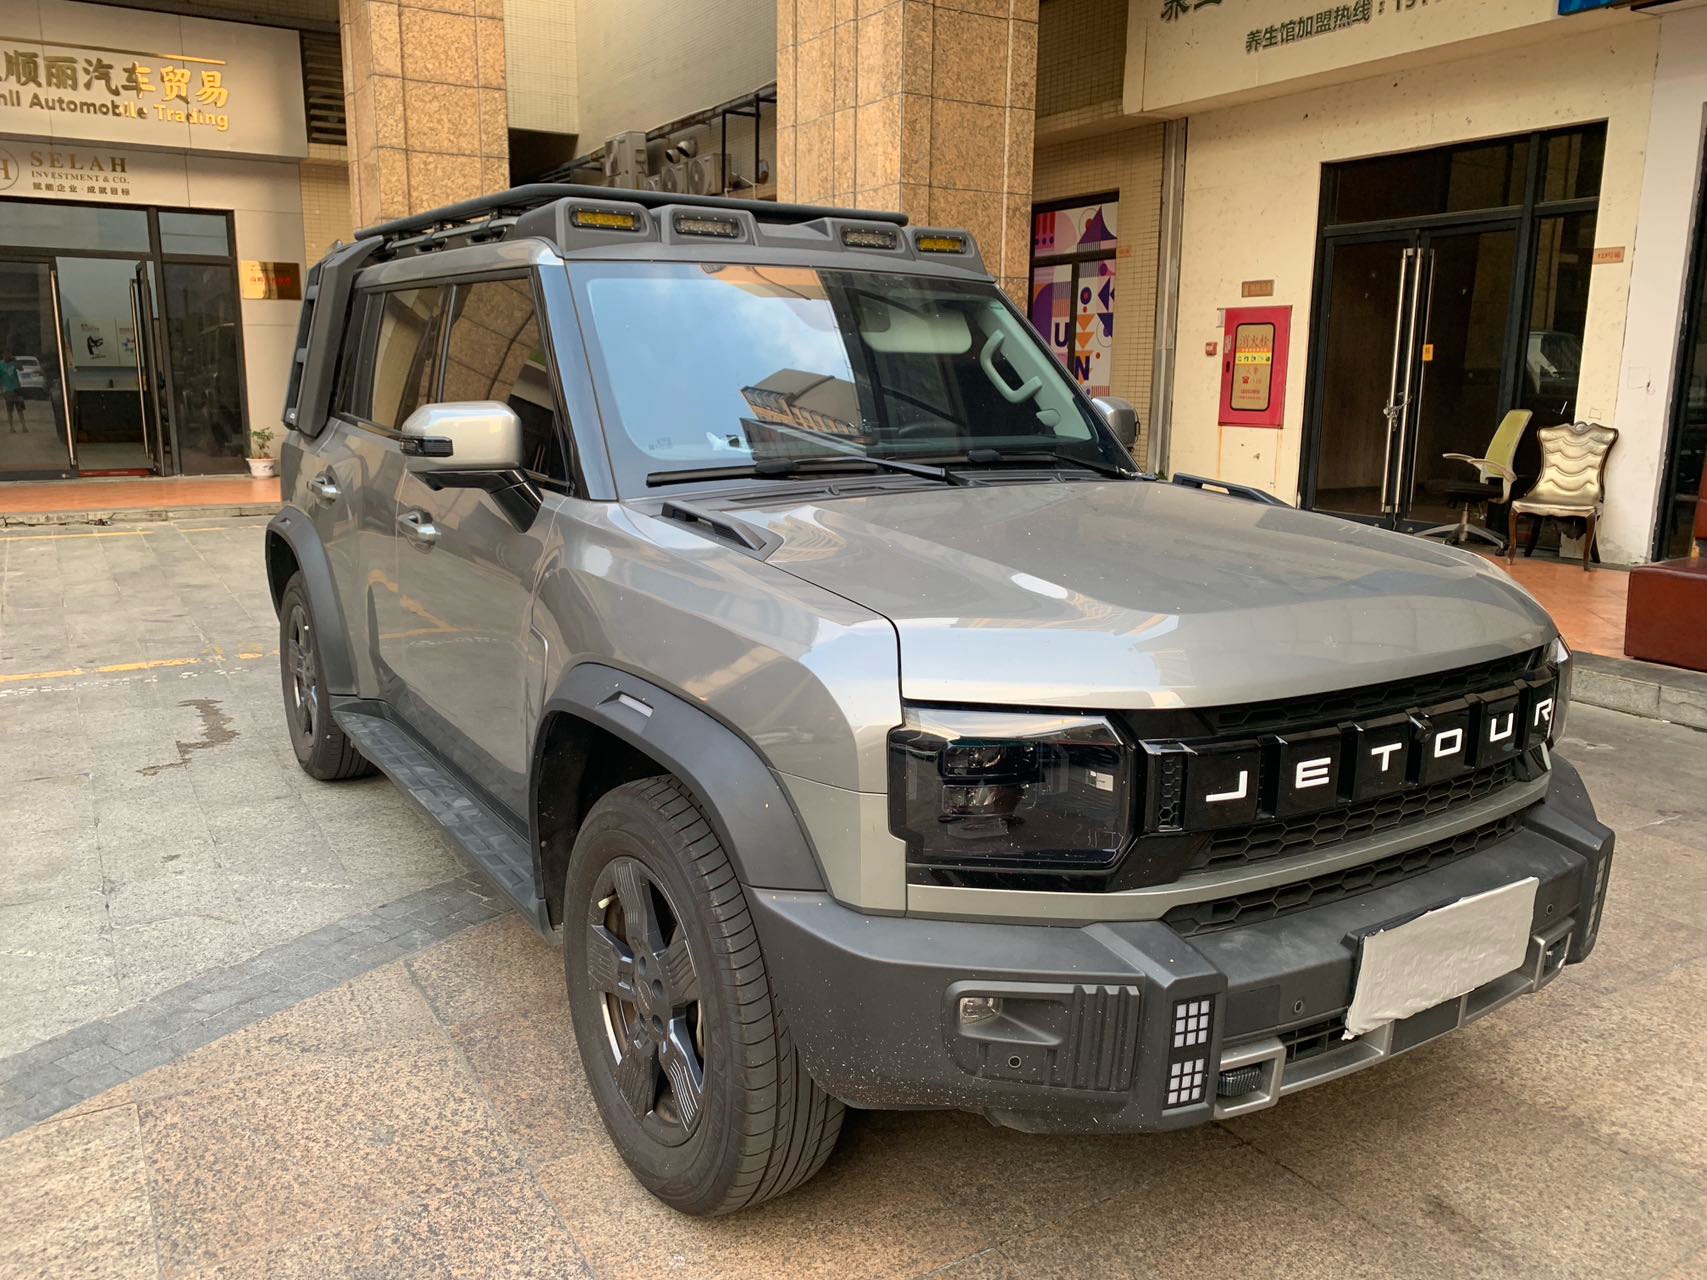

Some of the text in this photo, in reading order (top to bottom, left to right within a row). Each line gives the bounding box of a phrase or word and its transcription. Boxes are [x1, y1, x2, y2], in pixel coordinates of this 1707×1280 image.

[0, 49, 229, 108] 顺丽汽车贸易
[29, 92, 148, 120] Automobile
[153, 103, 229, 132] Trading
[30, 150, 128, 173] SELAH
[31, 170, 100, 182] INVESTMENT
[112, 176, 130, 184] CO.
[1205, 697, 1553, 802] JETOUR
